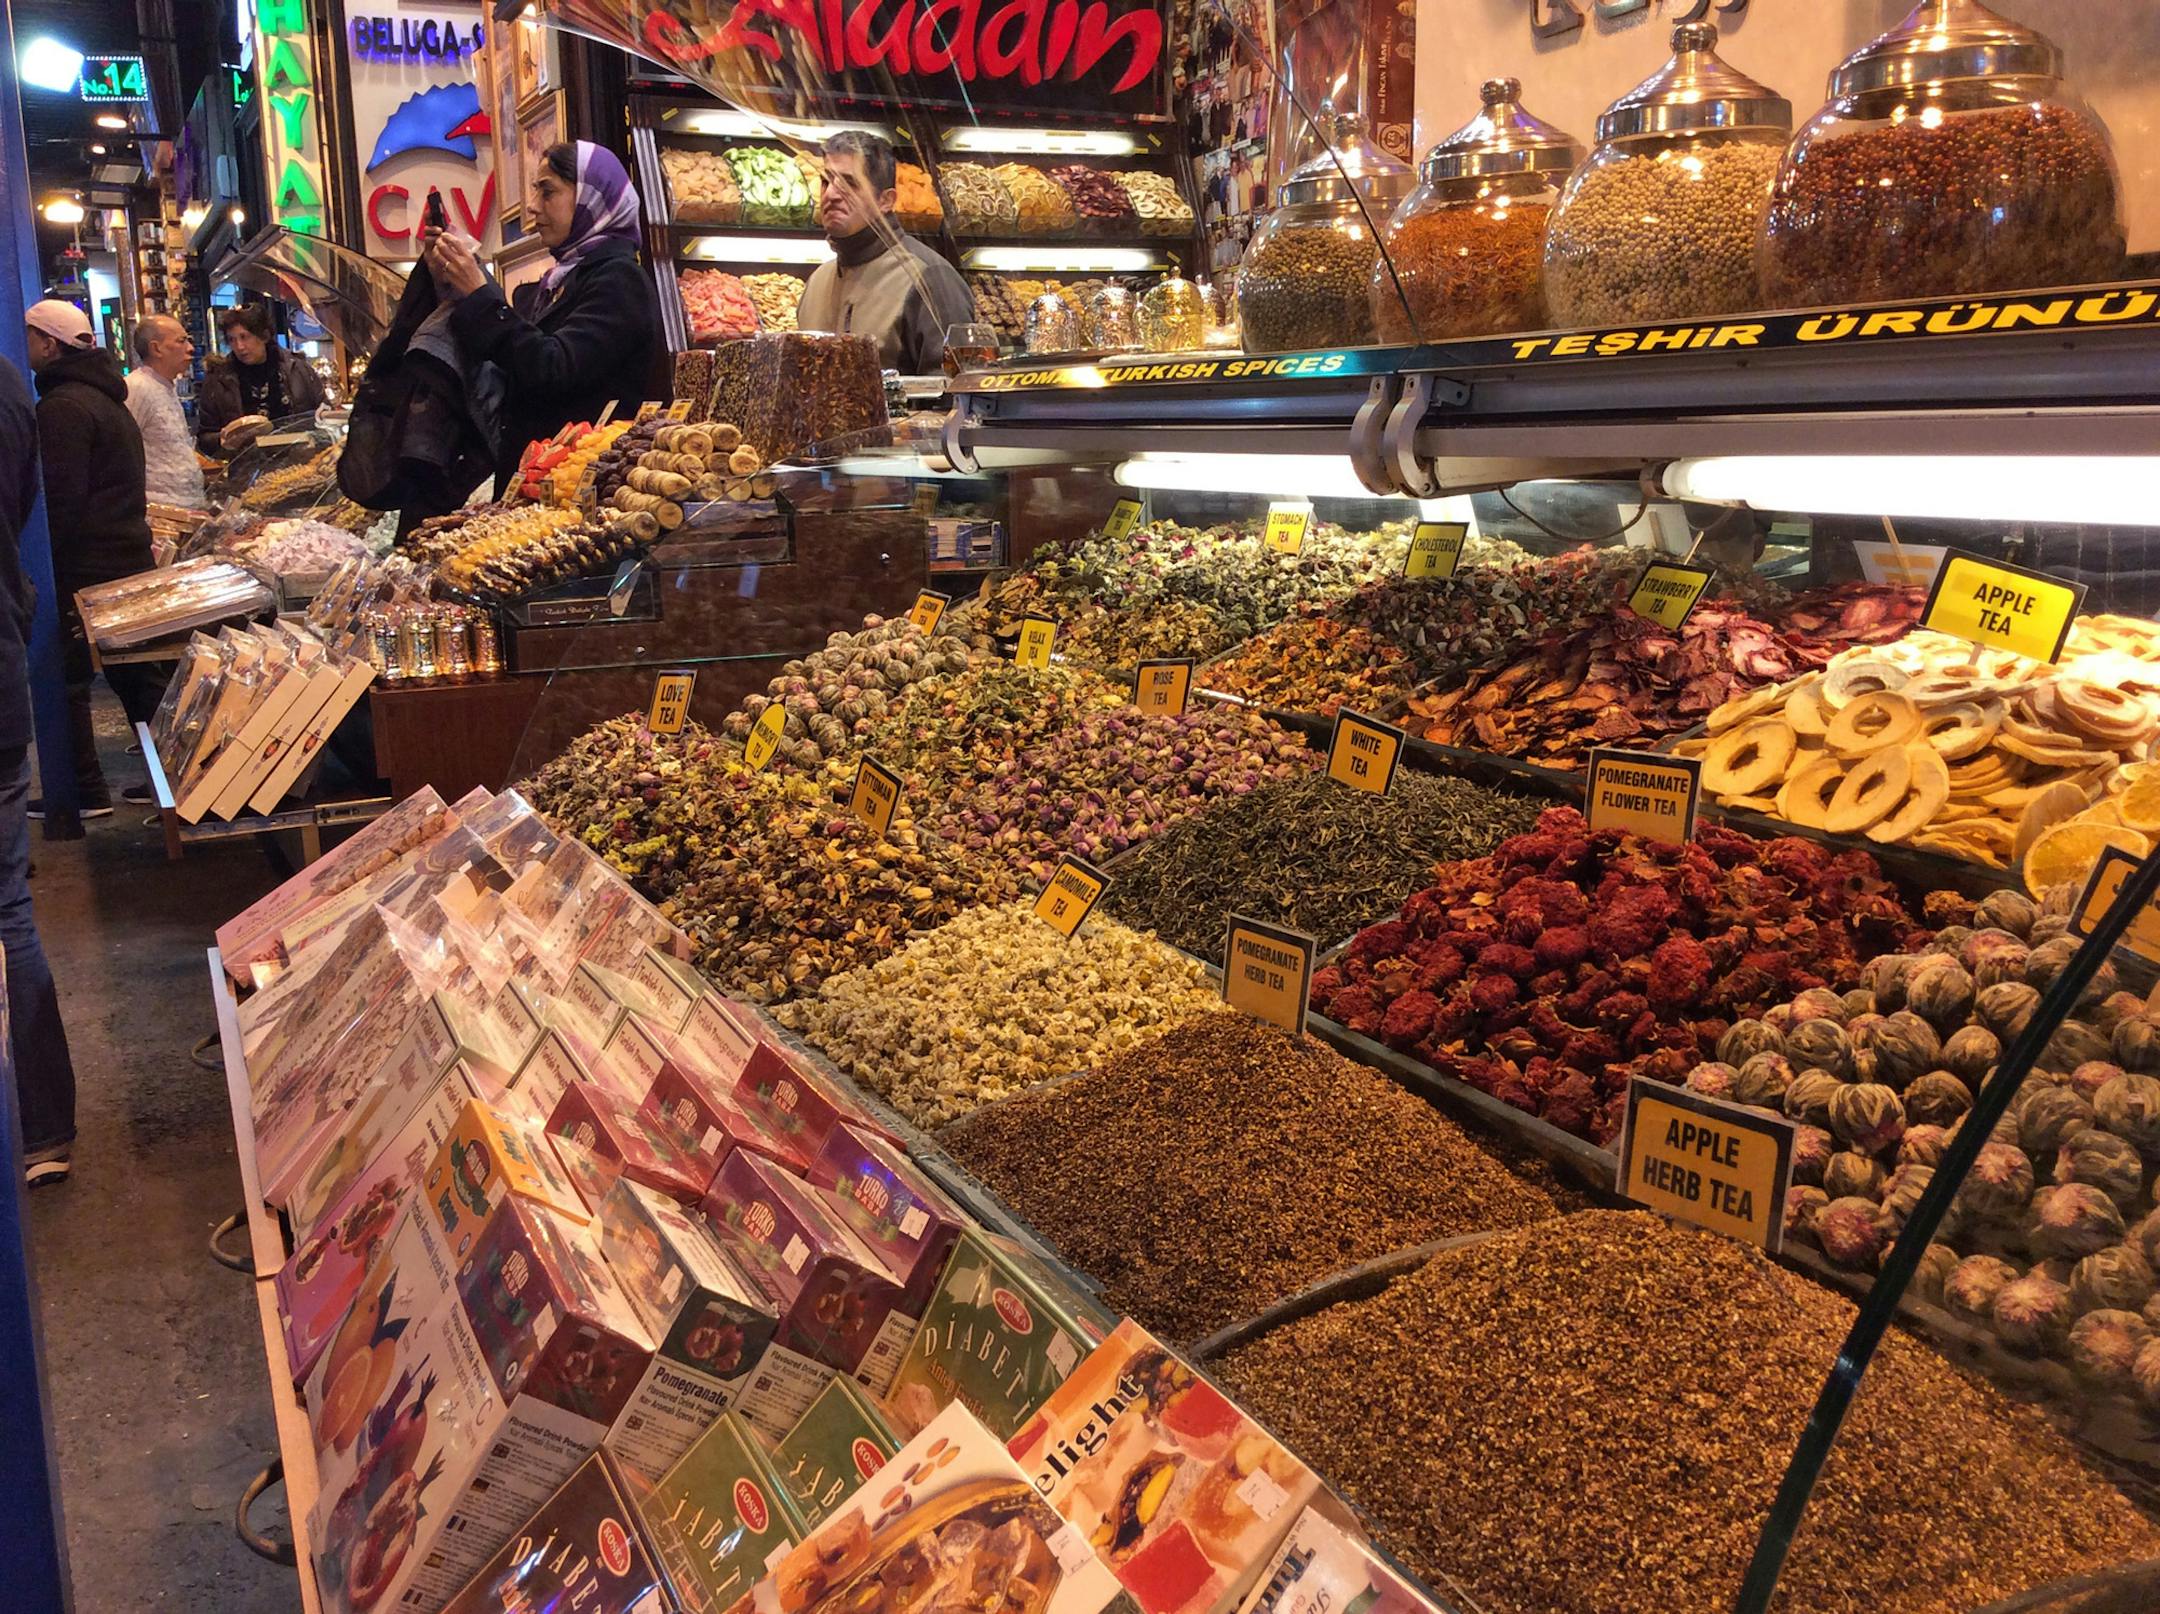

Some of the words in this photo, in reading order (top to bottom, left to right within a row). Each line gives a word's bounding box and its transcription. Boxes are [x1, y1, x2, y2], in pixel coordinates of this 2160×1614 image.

[354, 15, 484, 58] BELUGA-S
[367, 170, 497, 244] CAV
[1796, 290, 2160, 343] ÜRÜNÜ
[979, 366, 1096, 389] OTTOMA
[1100, 361, 1219, 383] TURKISH
[1222, 354, 1346, 377] SPICES
[1272, 512, 1303, 525] STOMACH
[1278, 531, 1289, 543] TEA
[1414, 537, 1459, 553] CHOLESTEROL
[1424, 554, 1437, 568] TEA
[1640, 577, 1699, 600] STRAWBERRY
[1973, 582, 2037, 616] APPLE
[1648, 598, 1668, 615] TEA
[1978, 608, 2012, 636] TEA
[1028, 630, 1047, 646] RELAX
[1028, 645, 1039, 660] TEA
[1153, 670, 1175, 686] ROSE
[661, 684, 686, 703] LOVE
[1153, 691, 1168, 706] TEA
[658, 706, 677, 726] TEA
[1350, 728, 1382, 756] WHITE
[1349, 755, 1369, 779] TEA
[1598, 767, 1689, 794] POMEGRANATE
[861, 769, 893, 802] OTTOMAN
[863, 797, 878, 819] TEA
[1601, 790, 1650, 813] FLOWER
[1654, 798, 1677, 817] TEA
[1054, 869, 1097, 905] CAMOMILE
[1050, 896, 1069, 920] TEA
[1236, 937, 1300, 973] POMEGRANATE
[1244, 962, 1267, 985] HERB
[1267, 971, 1285, 993] TEA
[777, 1079, 799, 1110] TURKO
[677, 1097, 698, 1128] TURKO
[1665, 1118, 1741, 1169] APPLE
[854, 1188, 881, 1217] BABA
[859, 1174, 889, 1210] TURKO
[1642, 1154, 1702, 1202] HERB
[1709, 1177, 1754, 1223] TEA
[743, 1215, 765, 1245] BABA
[750, 1200, 776, 1238] TURKO
[501, 1265, 518, 1298] BABA
[506, 1249, 530, 1290] TURKO
[999, 1295, 1028, 1329] KOSKA
[770, 1350, 802, 1370] Flavoured
[801, 1359, 818, 1376] Drink
[646, 1384, 679, 1406] Flavoured
[678, 1395, 696, 1410] Drink
[652, 1365, 729, 1408] Pomegranate
[507, 1415, 542, 1437] Flavoured
[542, 1427, 563, 1443] Drink
[563, 1436, 590, 1451] Powder
[1034, 1374, 1144, 1497] elight
[738, 1484, 764, 1528] KOSKA
[603, 1526, 625, 1569] KOSKA
